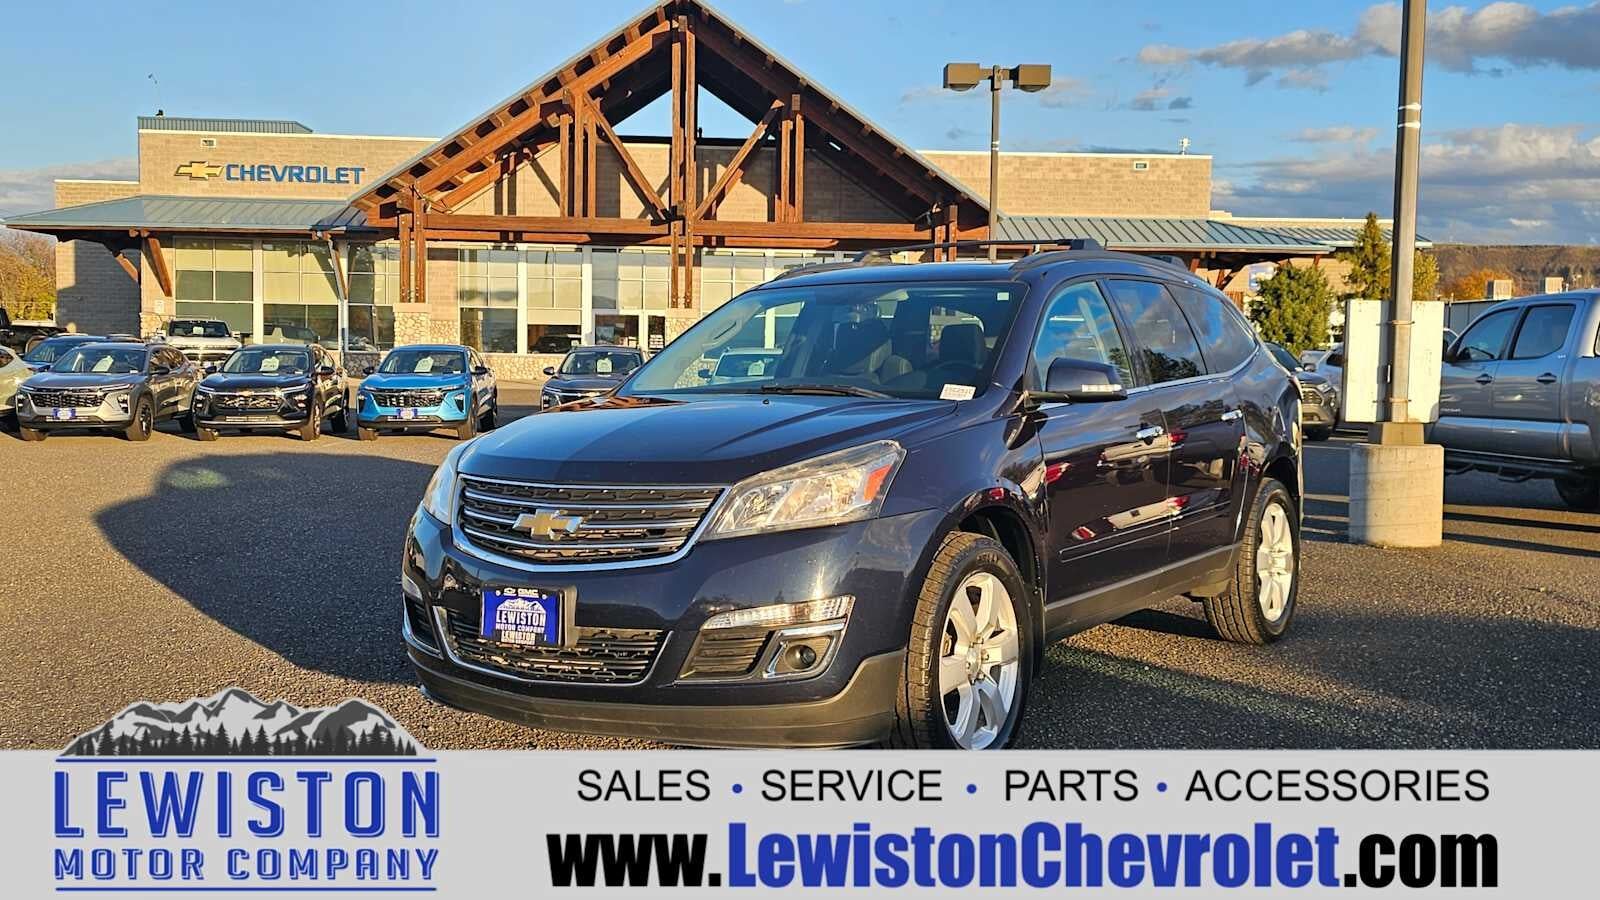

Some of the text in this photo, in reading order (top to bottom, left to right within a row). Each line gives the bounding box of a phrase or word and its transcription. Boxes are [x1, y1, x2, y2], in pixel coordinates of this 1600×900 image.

[226, 164, 365, 185] CHEVROLET
[496, 610, 546, 627] LEWISTON
[495, 623, 545, 634] MOTOR COMPANY
